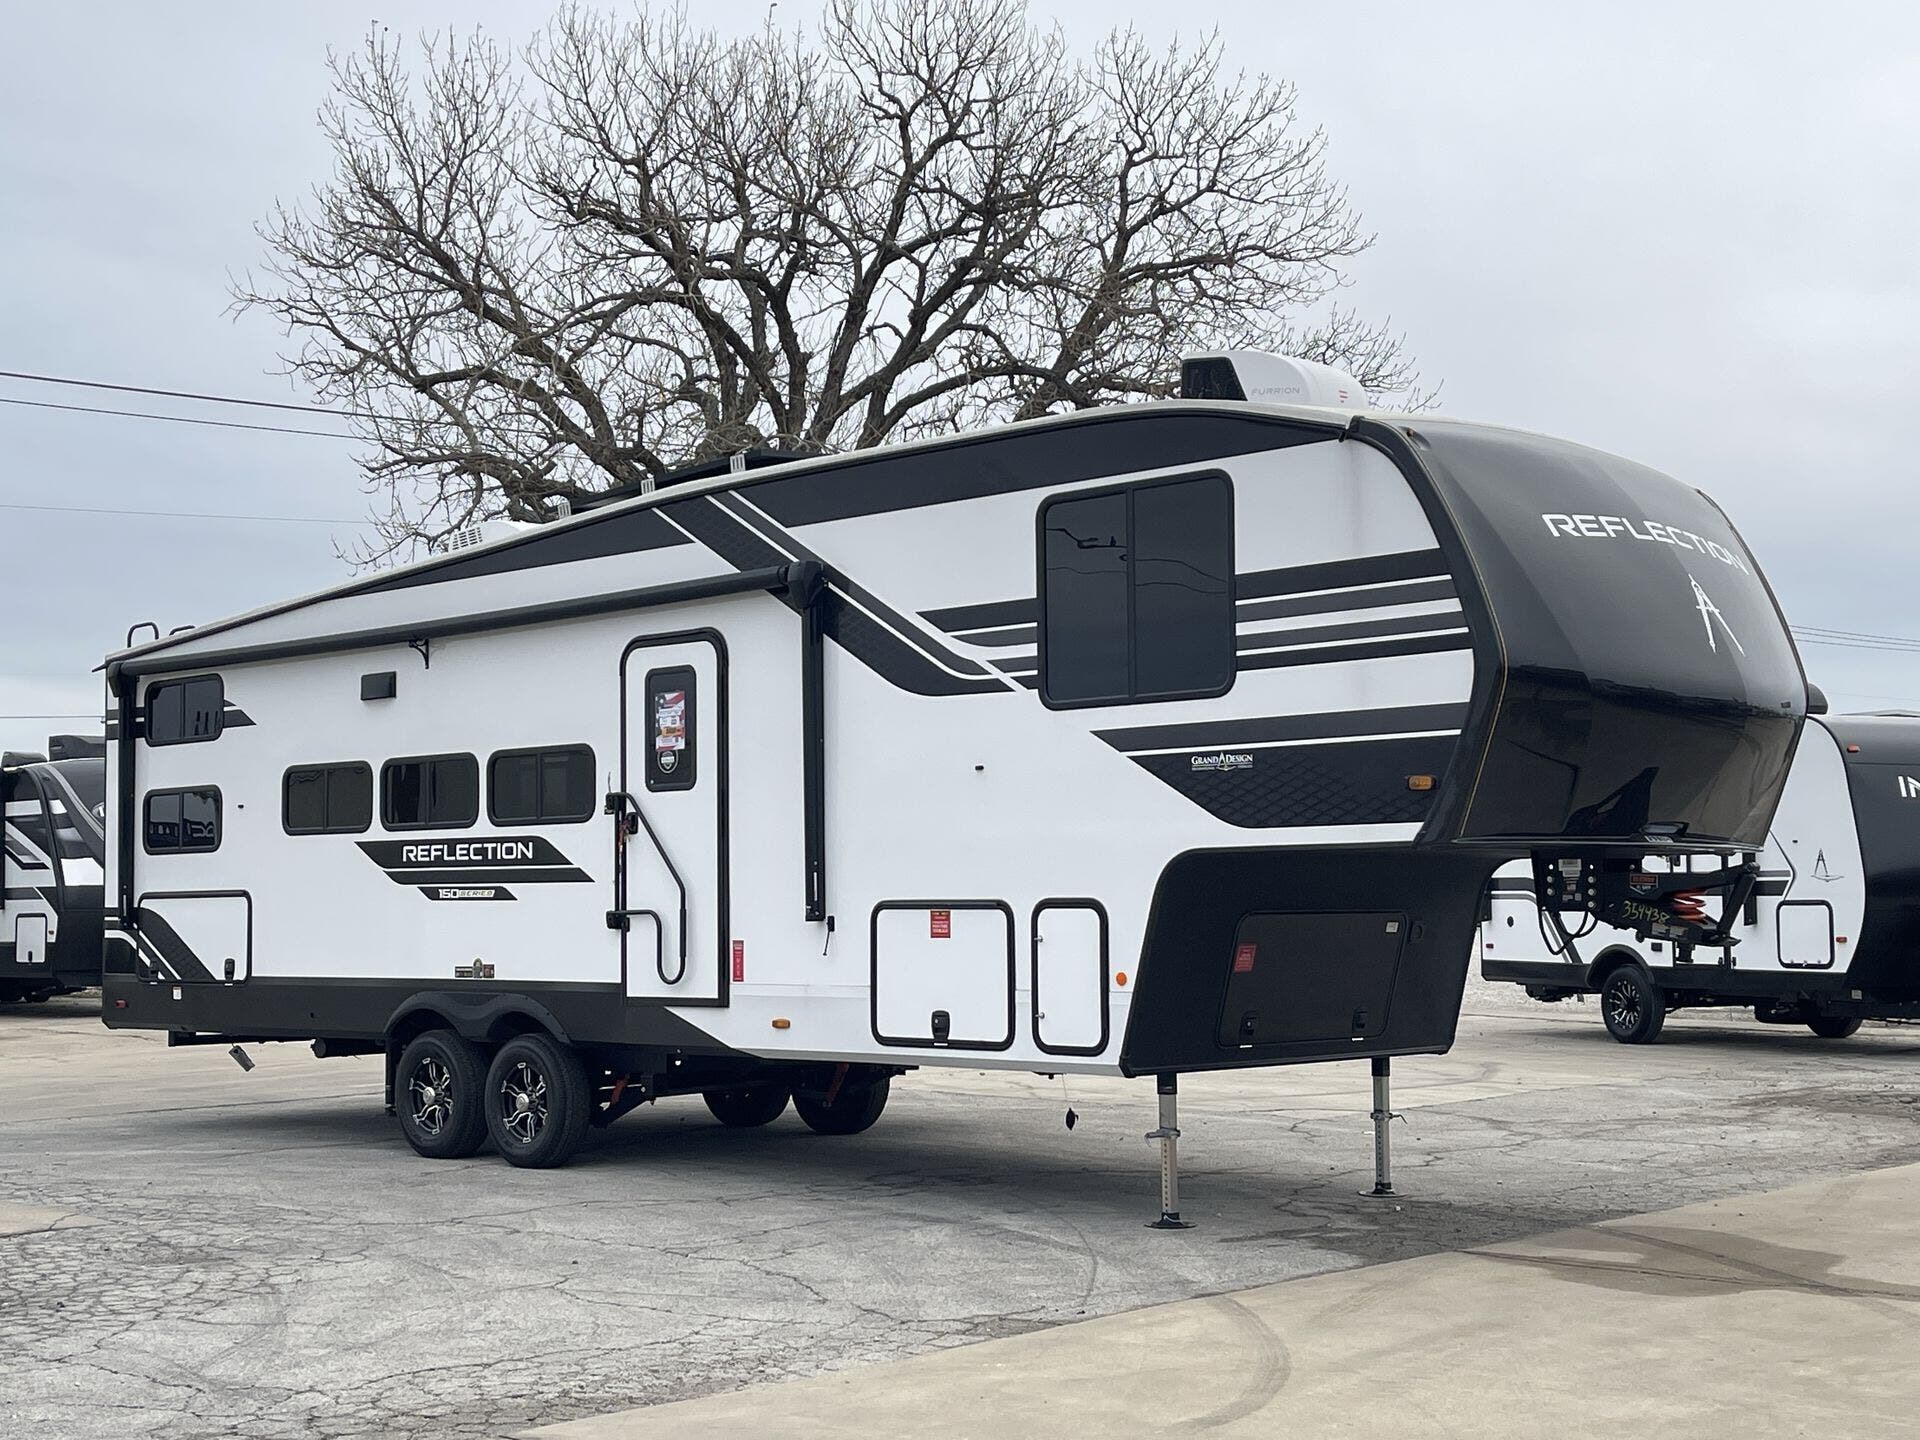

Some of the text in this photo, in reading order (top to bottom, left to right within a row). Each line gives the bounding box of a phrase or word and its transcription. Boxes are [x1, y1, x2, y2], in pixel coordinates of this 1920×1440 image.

[1251, 386, 1300, 396] FURRION
[1541, 513, 1750, 576] REFLECTION
[1191, 754, 1253, 765] GRAND DESIGN
[402, 842, 533, 862] REFLECTION
